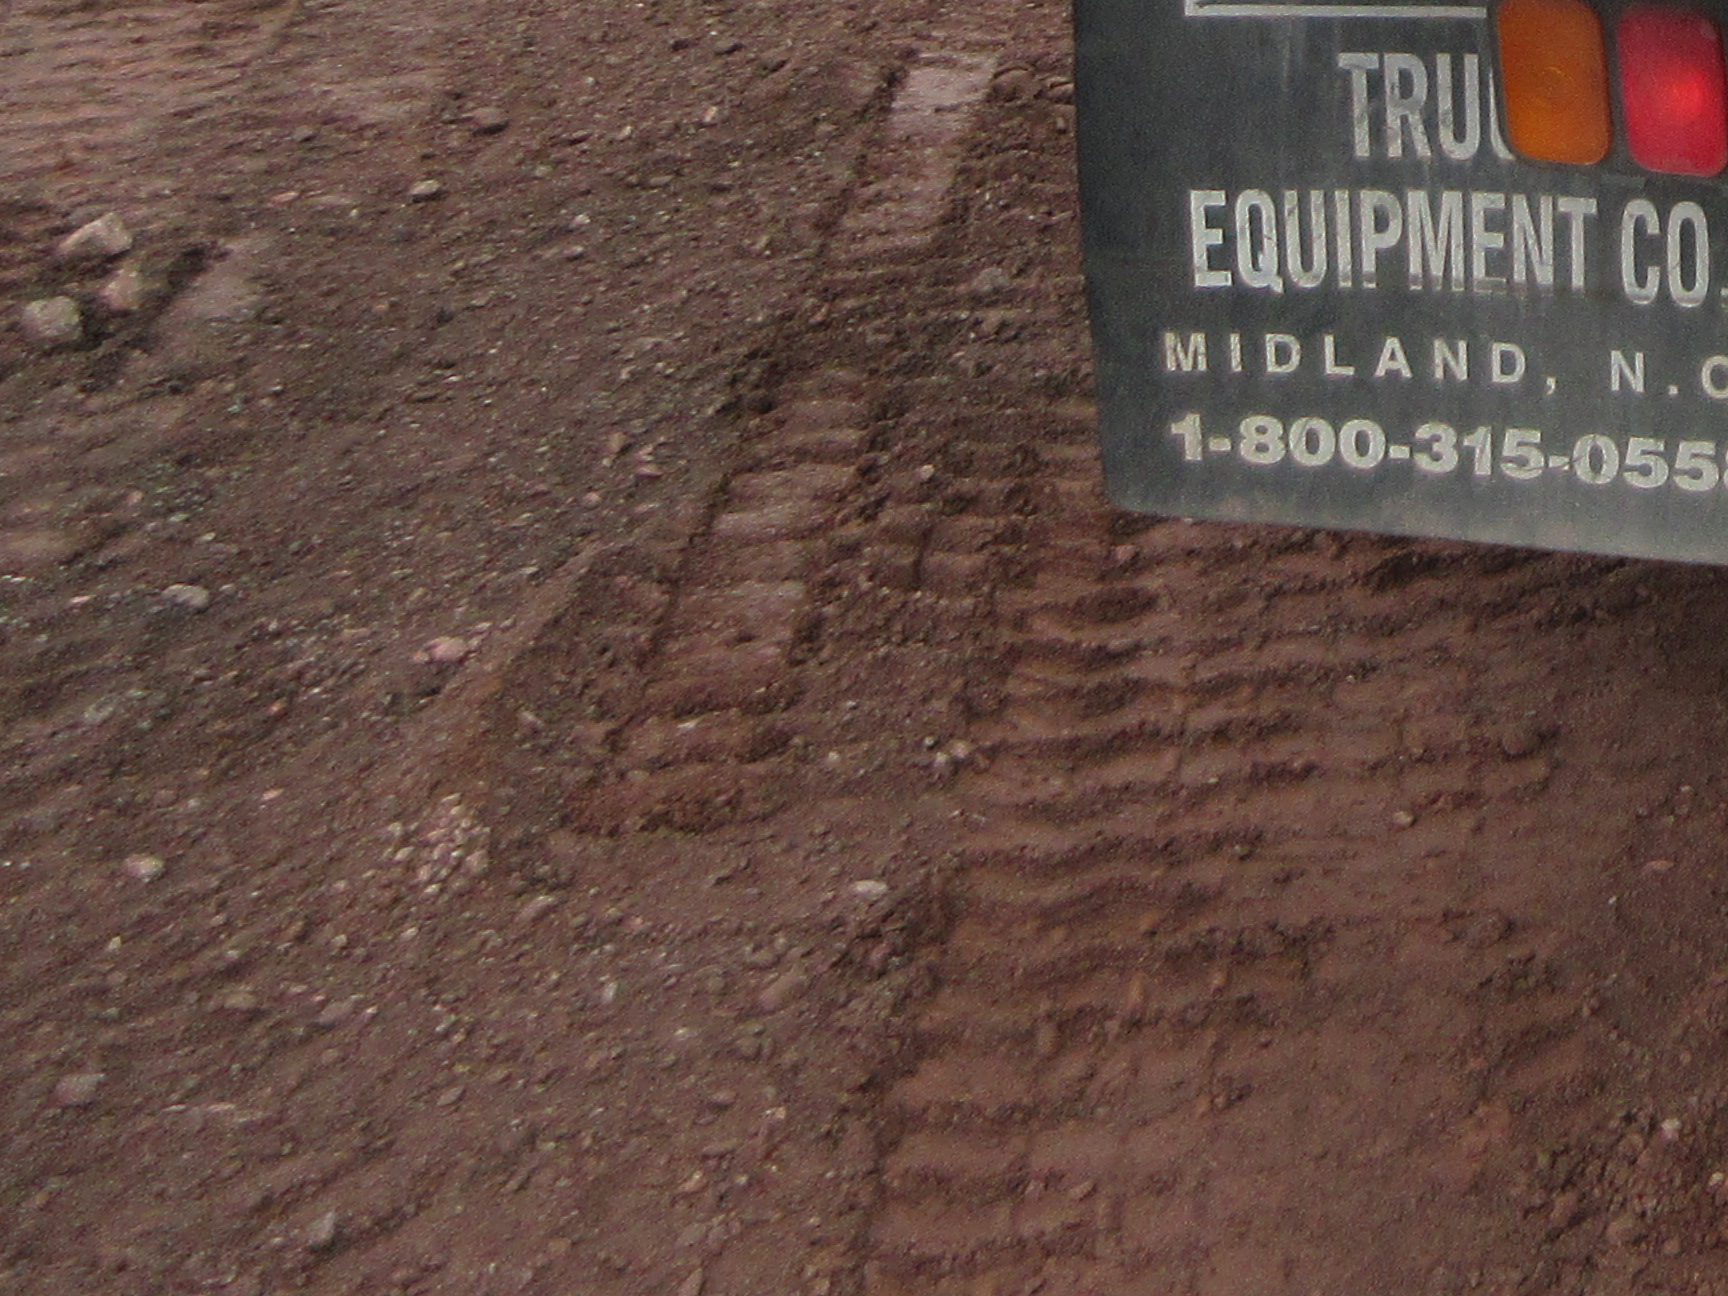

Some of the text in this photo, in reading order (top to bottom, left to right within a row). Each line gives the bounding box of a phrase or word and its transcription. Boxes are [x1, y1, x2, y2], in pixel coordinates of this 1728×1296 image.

[1337, 52, 1515, 159] TRU
[1189, 188, 1598, 295] EQUIPMENT
[1164, 331, 1557, 394] MIDLAND,
